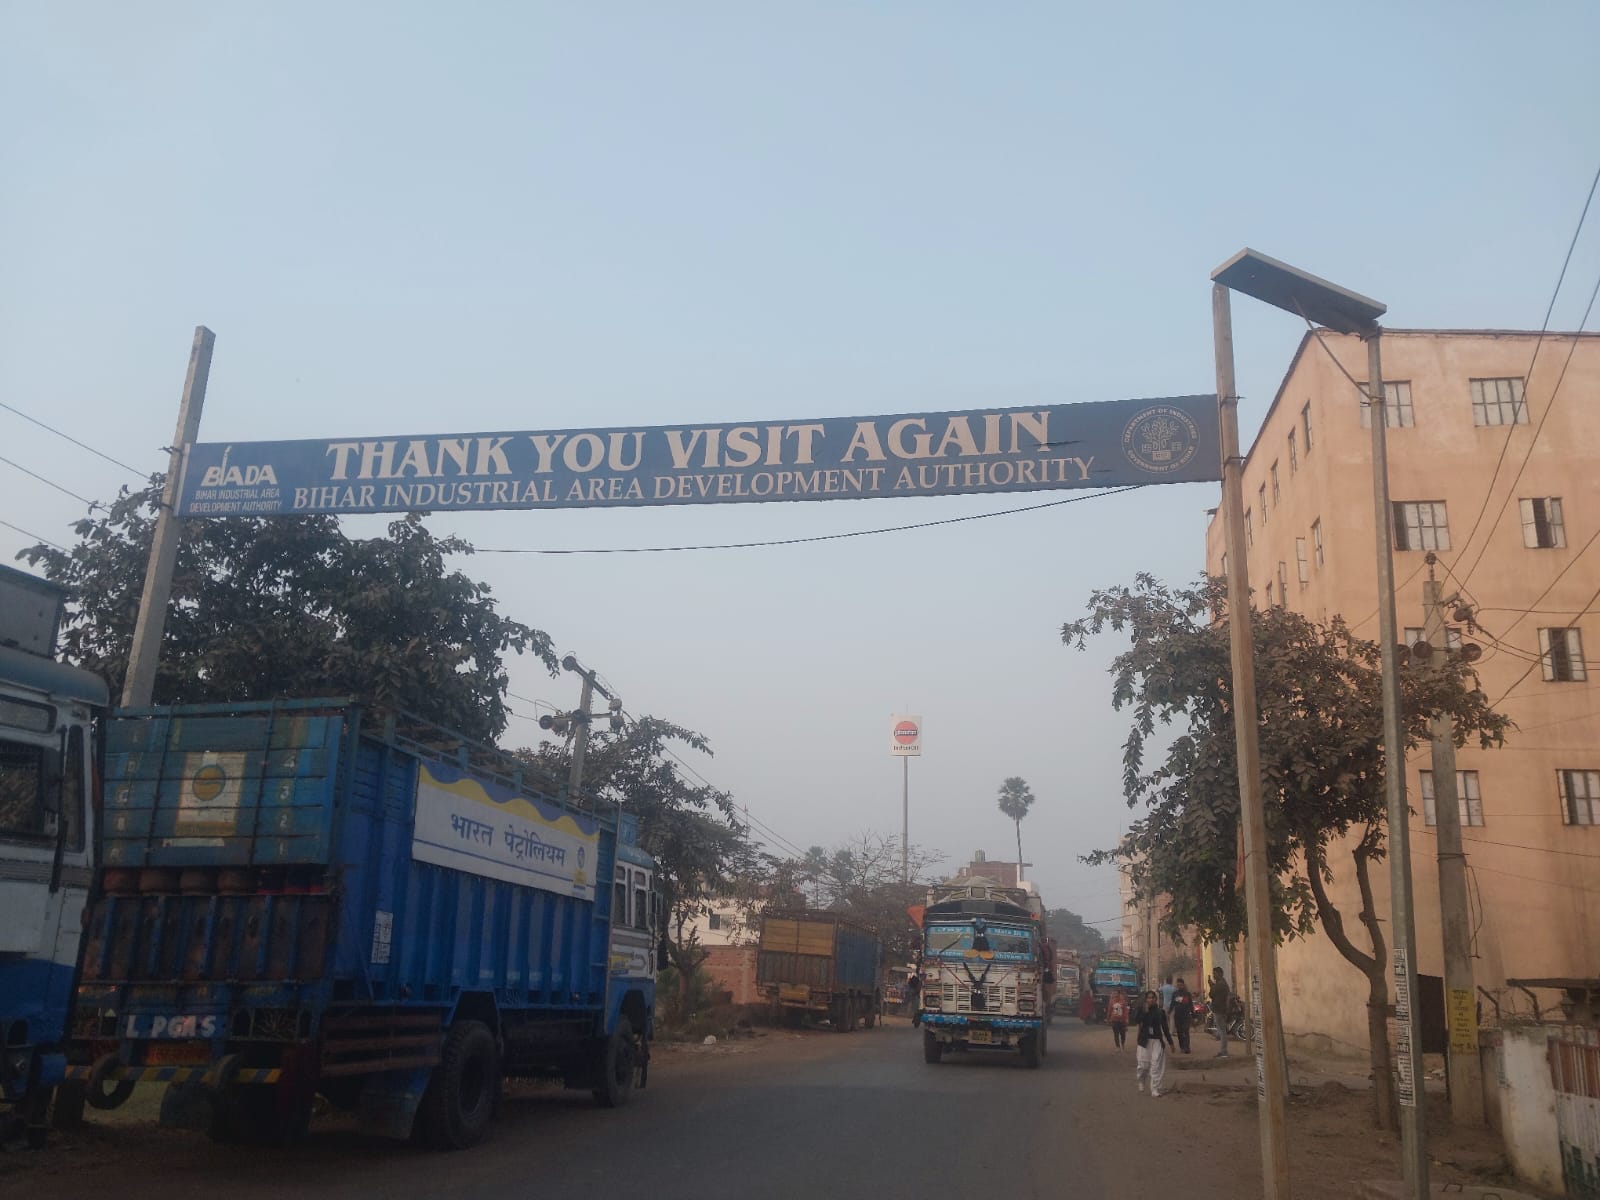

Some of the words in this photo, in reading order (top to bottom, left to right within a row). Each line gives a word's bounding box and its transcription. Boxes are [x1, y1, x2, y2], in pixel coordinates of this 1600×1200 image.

[1124, 409, 1156, 443] DEPARTMENT
[1169, 409, 1197, 439] INDUSTRIES
[325, 436, 514, 480] THANK
[529, 431, 646, 474] YOU
[664, 424, 825, 468] VISIT
[840, 411, 1052, 462] AGAIN
[200, 449, 278, 486] BIADA
[293, 485, 376, 510] BIHAR
[382, 479, 558, 507] INDUSTRIAL
[566, 476, 647, 501] AREA
[653, 468, 885, 499] DEVELOPMENT
[894, 456, 1094, 489] AUTHORITY
[189, 502, 241, 513] DEVELOPMENT
[241, 500, 282, 512] AUTHORITY
[195, 490, 217, 500] BIHAR
[218, 489, 258, 500] INDUSTRIAL
[260, 487, 280, 498] AREA
[451, 813, 494, 846] भारत
[504, 824, 567, 867] पेट्रोलियम
